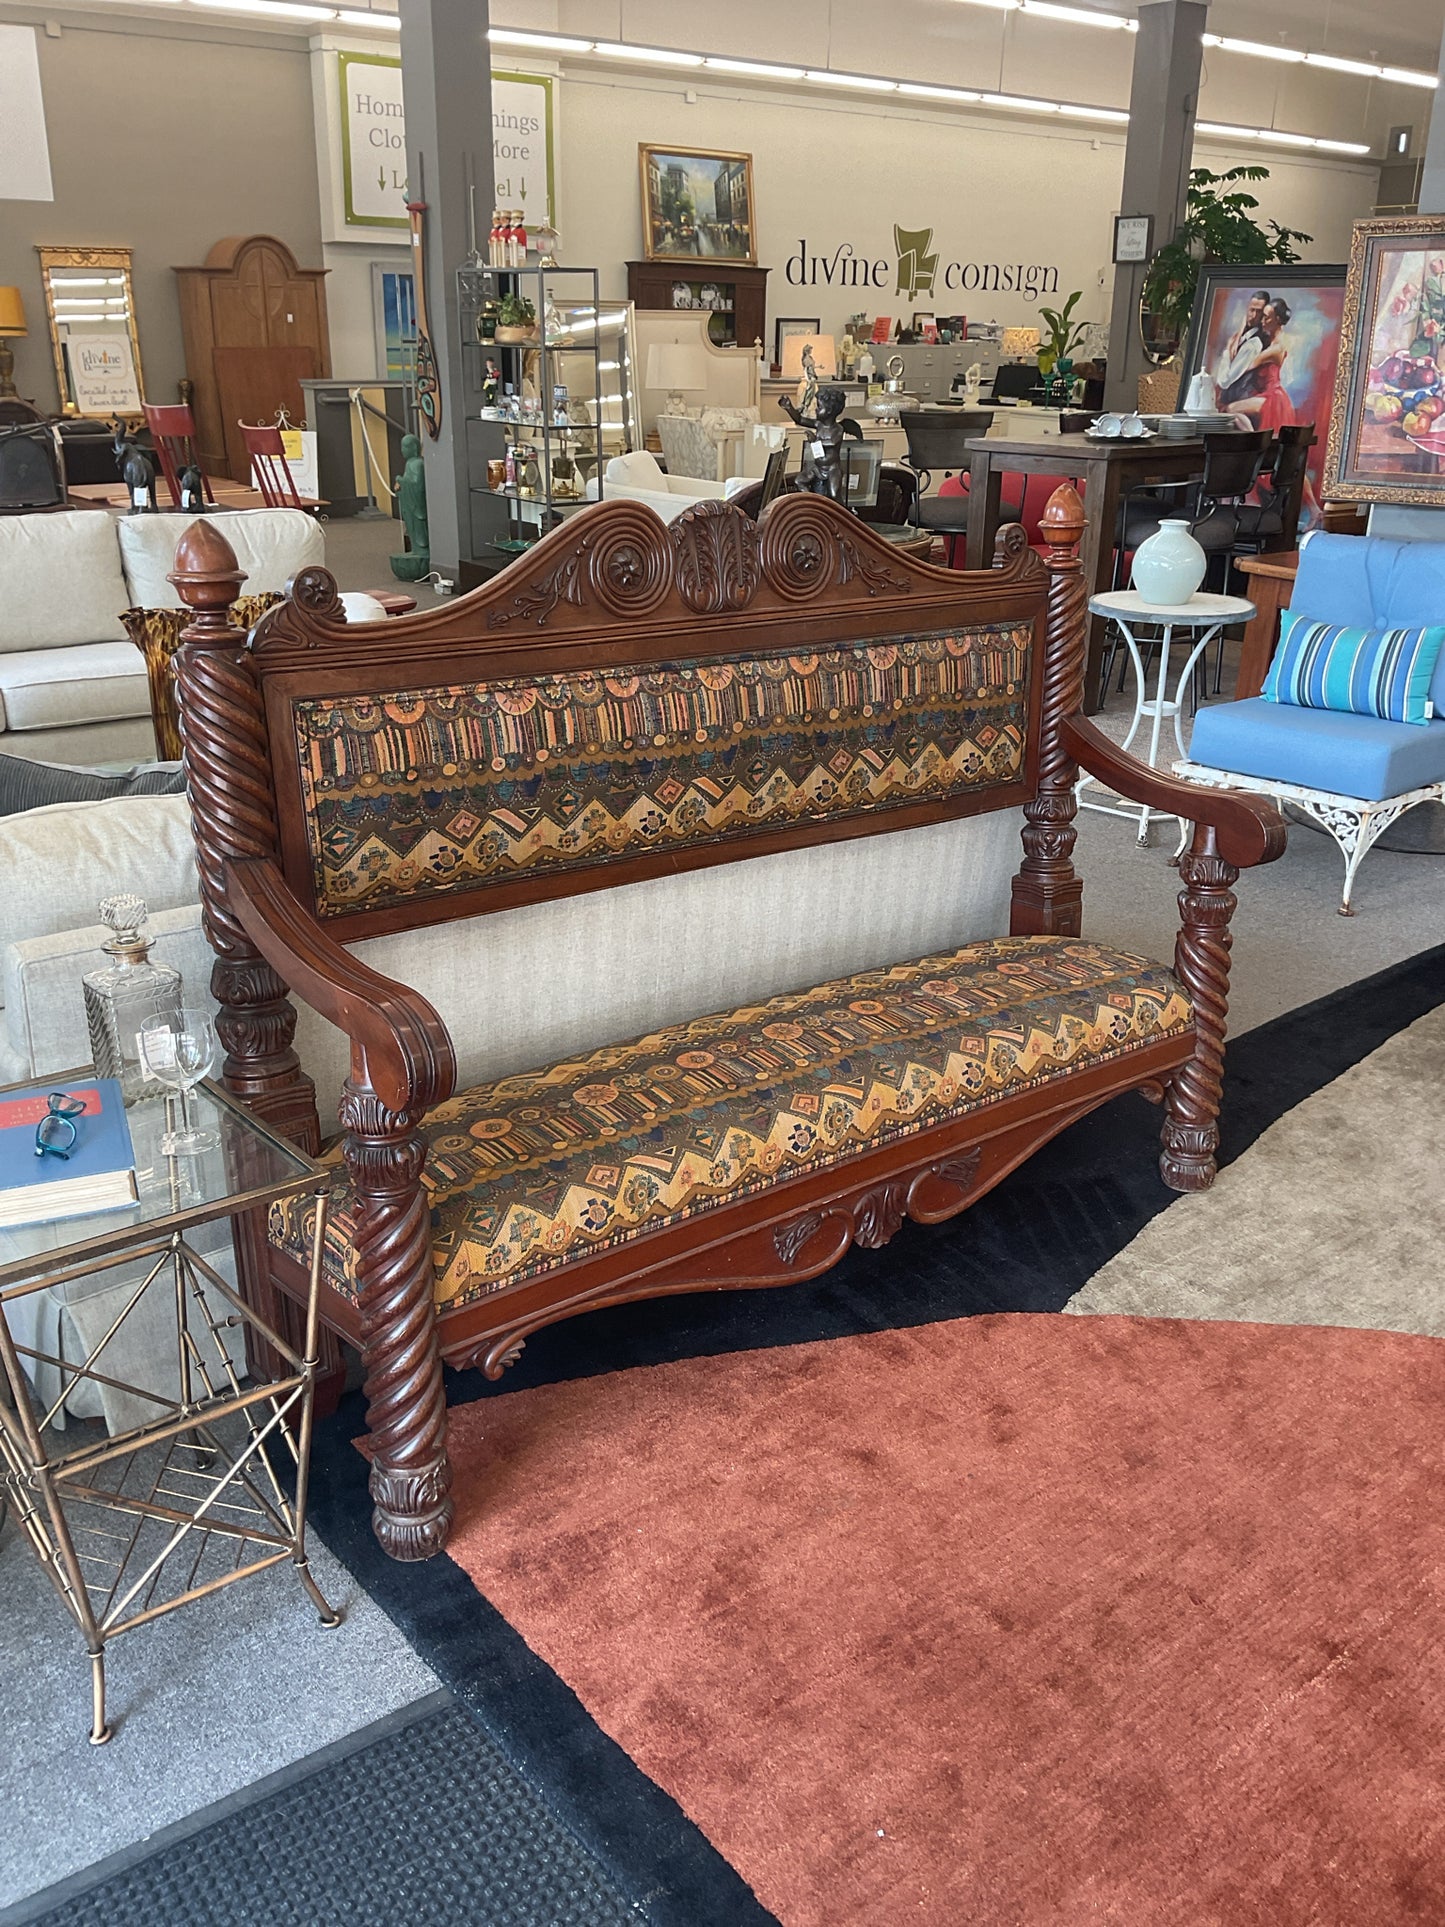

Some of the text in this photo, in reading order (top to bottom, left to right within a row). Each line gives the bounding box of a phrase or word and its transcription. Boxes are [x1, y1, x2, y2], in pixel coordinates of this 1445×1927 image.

[356, 94, 405, 118] Hom
[785, 239, 1059, 302] divine consign
